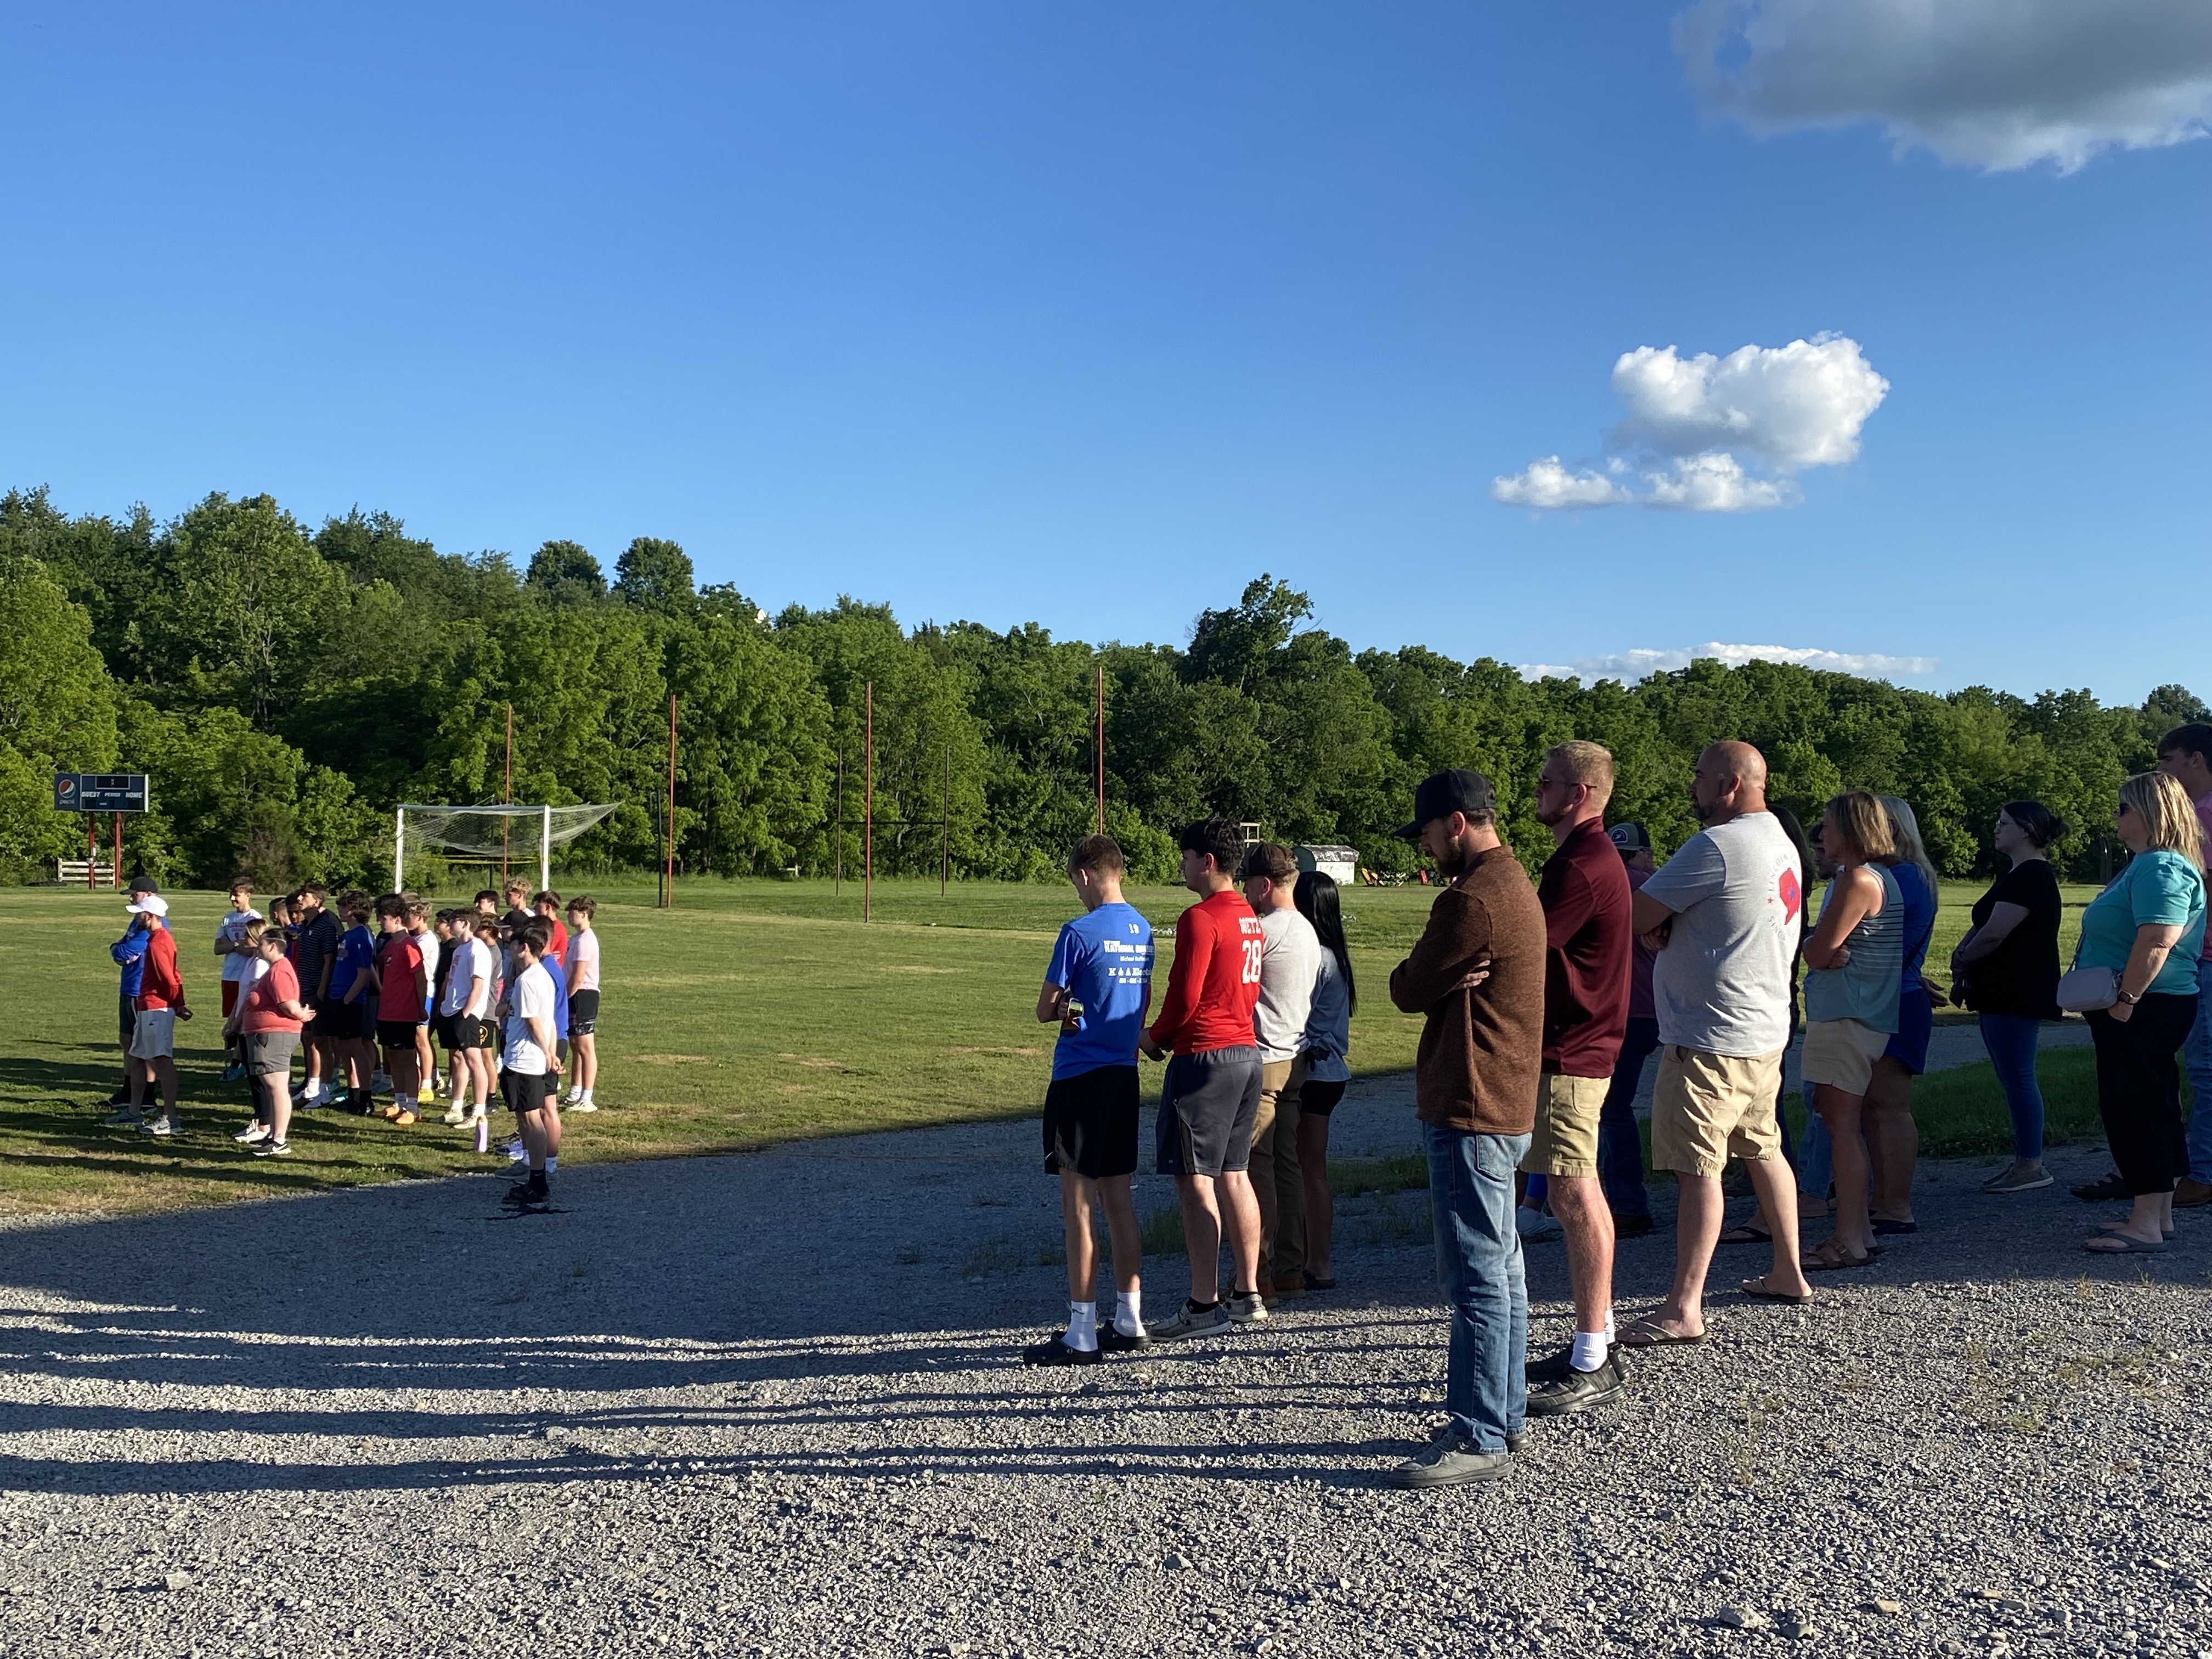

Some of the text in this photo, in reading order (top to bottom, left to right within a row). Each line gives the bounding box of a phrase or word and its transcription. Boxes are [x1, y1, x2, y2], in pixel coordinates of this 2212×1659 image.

[1768, 854, 1788, 891] LINCOLN
[1125, 967, 1131, 977] A
[1242, 940, 1262, 984] 28
